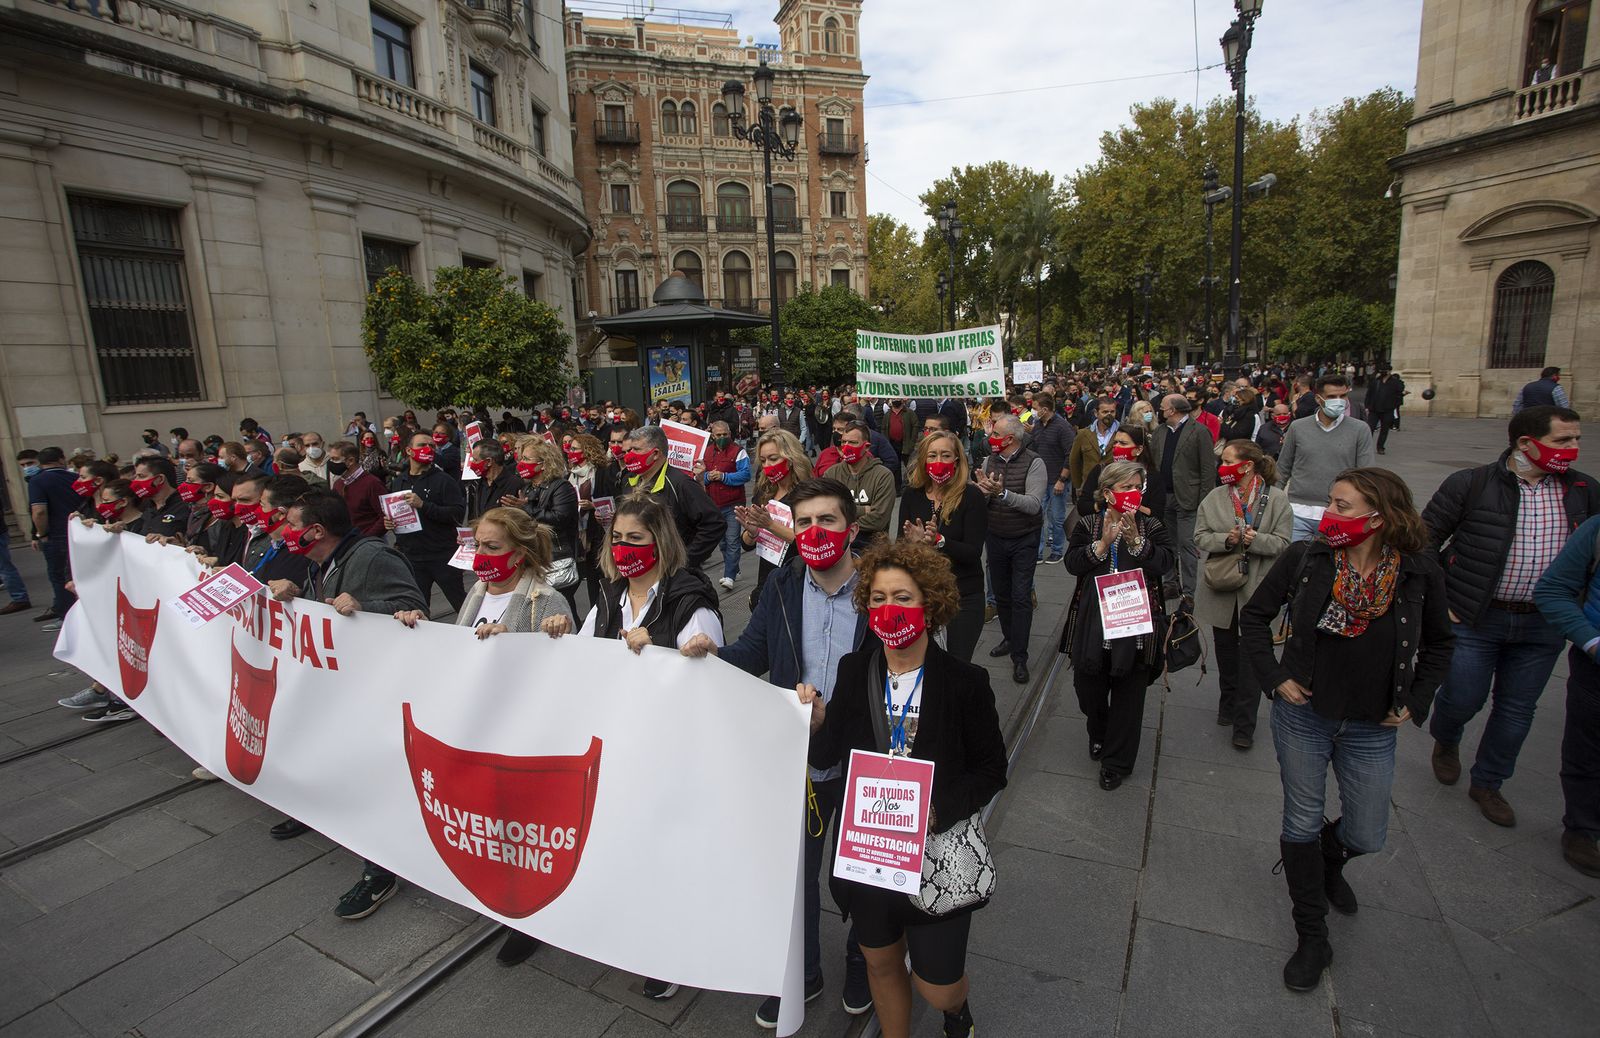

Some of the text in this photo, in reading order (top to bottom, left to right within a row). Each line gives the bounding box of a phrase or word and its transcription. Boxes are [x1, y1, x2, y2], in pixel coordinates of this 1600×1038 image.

[856, 330, 995, 354] SIN CATERING NO HAY FERIAS
[856, 358, 871, 374] SIN
[873, 359, 907, 377] FERIAS
[909, 362, 931, 377] UNA
[932, 360, 968, 377] RUINA
[654, 382, 685, 398] ¡SALTA!
[856, 380, 1003, 397] AYUDAS URGENTES S.O.S.
[800, 541, 835, 553] SALVEMOSLA
[801, 549, 836, 561] HOSTELERIA
[283, 608, 339, 671] YA!
[873, 623, 916, 639] SALVEMOSLA
[231, 688, 265, 738] SALVEMOSLA
[229, 706, 263, 757] HOSTELERIA
[421, 767, 435, 792] #
[862, 785, 915, 802] SIN AYUDAS
[872, 797, 901, 814] Nos
[423, 790, 577, 850] SALVEMOSLOS
[860, 809, 914, 828] Arruinan!
[443, 825, 554, 874] CATERING
[845, 829, 920, 856] MANIFESTACIÓN
